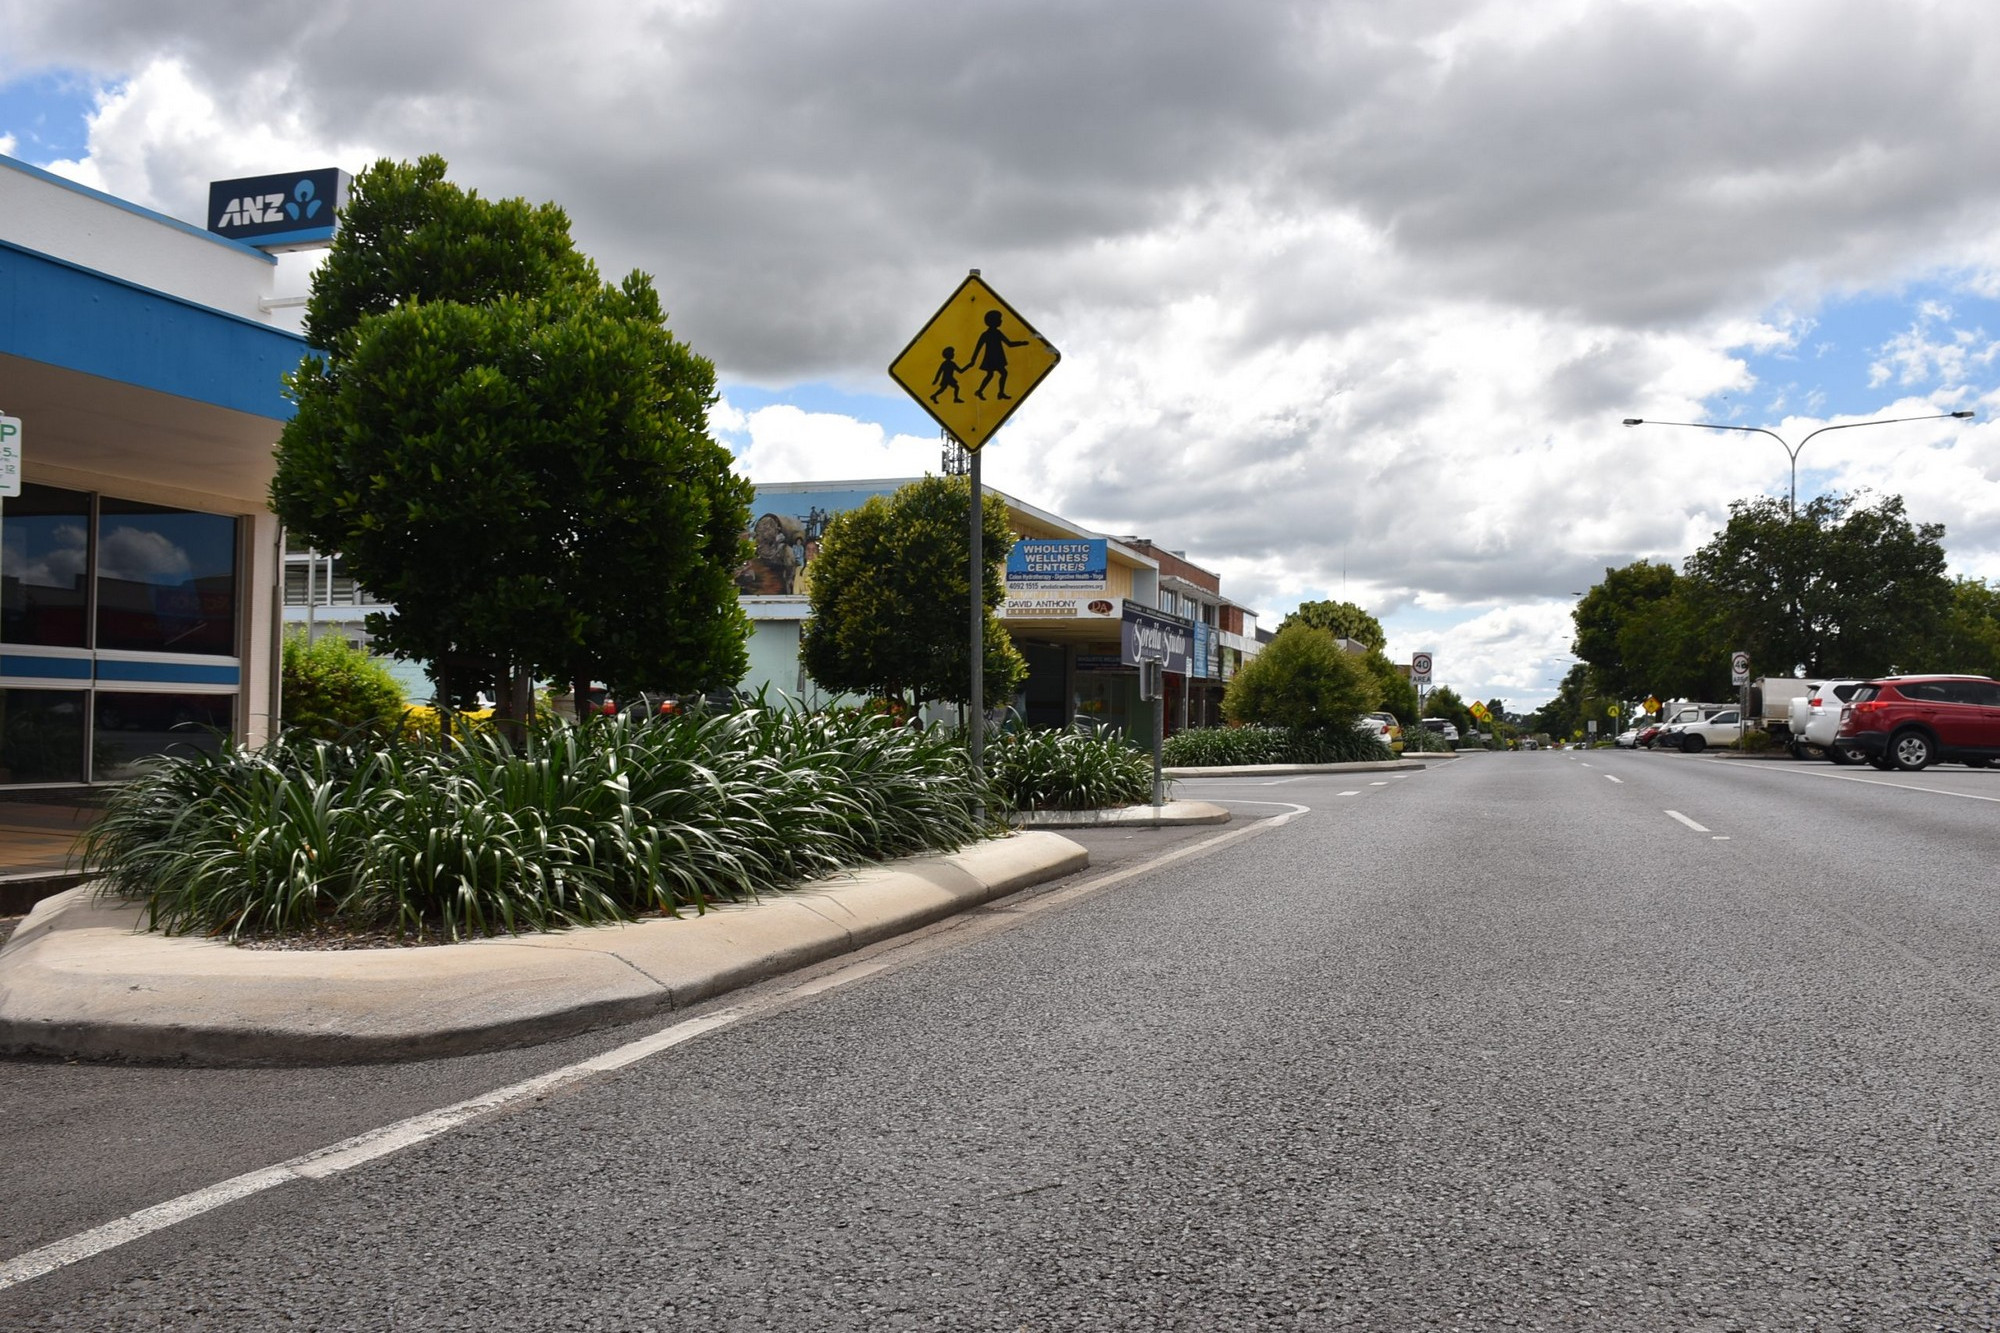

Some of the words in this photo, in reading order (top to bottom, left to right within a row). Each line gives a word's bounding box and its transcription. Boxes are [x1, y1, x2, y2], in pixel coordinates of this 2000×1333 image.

[217, 193, 285, 228] ANZ
[1024, 544, 1090, 553] WHOLISTIC
[1026, 554, 1088, 562] WELLNESS
[1028, 563, 1085, 572] CENTRE/S
[1416, 660, 1428, 669] 40
